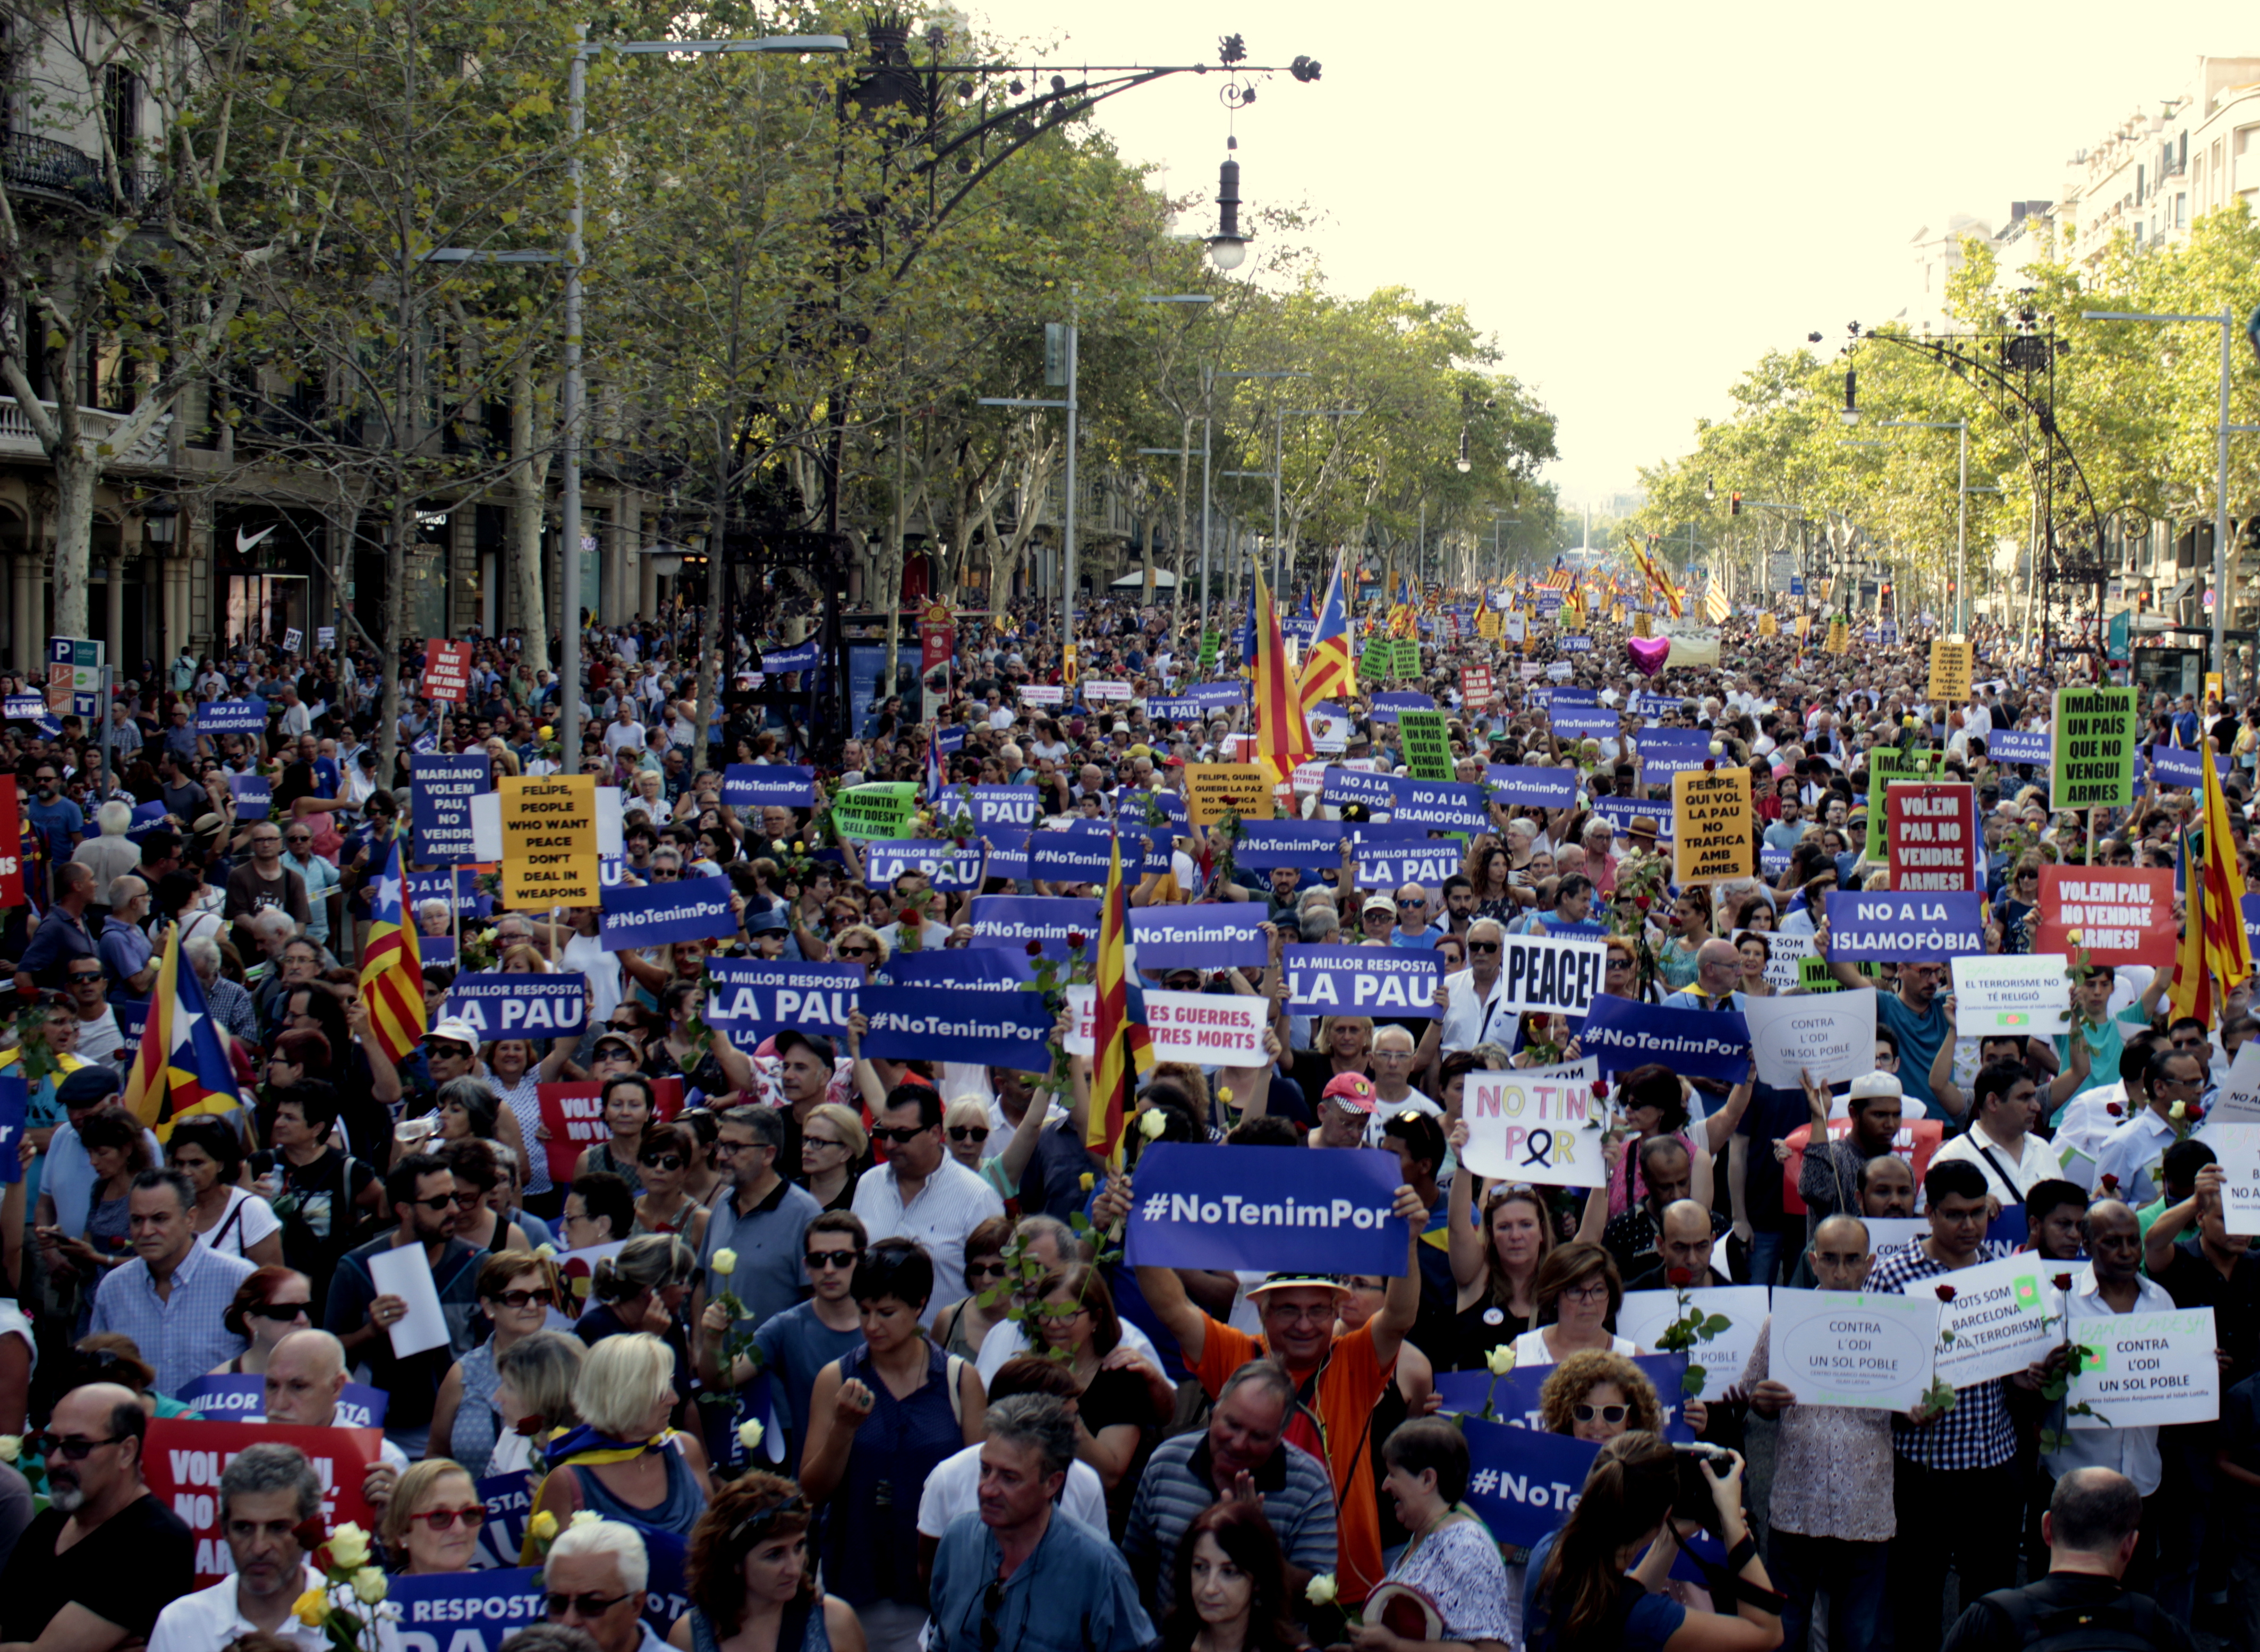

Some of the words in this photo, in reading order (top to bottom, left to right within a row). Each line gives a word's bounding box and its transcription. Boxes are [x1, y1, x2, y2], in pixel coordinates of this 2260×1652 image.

[56, 642, 70, 660] P
[5, 704, 19, 716] LA
[210, 707, 225, 716] NO
[1148, 705, 1167, 719] LA
[1170, 704, 1200, 718] PAU
[2065, 695, 2130, 714] IMAGINA
[1403, 716, 1441, 727] IMAGINA
[1554, 719, 1615, 728] #NoTenimPor
[2068, 719, 2089, 735] UN
[2092, 713, 2125, 735] PAÍS
[1407, 730, 1423, 740] UN
[1425, 727, 1441, 740] PAÍS
[1411, 743, 1428, 754] QUE
[1430, 743, 1442, 753] NO
[2069, 740, 2095, 760] QUE
[2098, 739, 2121, 757] NO
[1412, 756, 1444, 767] VENGUI
[415, 768, 484, 780] MARIANO
[1197, 774, 1230, 782] FELIPE,
[1416, 769, 1447, 780] ARMES
[2066, 762, 2120, 780] VENGUI
[425, 784, 475, 795] VOLEM
[522, 786, 572, 797] FELIPE,
[725, 780, 809, 793] #NoTenimPor
[1491, 777, 1570, 795] #NoTenimPor
[1687, 779, 1738, 792] FELIPE,
[2068, 784, 2119, 802] ARMES
[434, 798, 467, 812] PAU,
[1685, 793, 1710, 806] QUI
[1713, 792, 1742, 803] VOL
[1901, 797, 1959, 816] VOLEM
[521, 803, 574, 813] PEOPLE
[838, 807, 862, 820] THAT
[864, 809, 905, 824] DOESN'T
[1689, 808, 1707, 819] LA
[1710, 805, 1740, 818] PAU
[438, 813, 460, 824] NO
[1394, 808, 1486, 827] ISLAMOFÒBIA
[508, 821, 542, 831] WHO
[547, 820, 589, 830] WANT
[842, 821, 863, 834] SELL
[865, 824, 895, 837] ARMS
[1703, 821, 1723, 832] NO
[1685, 834, 1745, 849] TRAFICA
[1901, 822, 1937, 846] PAU,
[1941, 822, 1961, 841] NO
[526, 837, 572, 847] PEACE
[1237, 838, 1336, 853] #NoTenimPor
[529, 854, 571, 864] DON'T
[1358, 850, 1372, 859] LA
[1374, 849, 1408, 859] MILLOR
[1411, 847, 1458, 858] RESPOSTA
[1700, 849, 1731, 861] AMB
[1899, 847, 1964, 867] VENDRE
[524, 871, 559, 882] DEAL
[564, 870, 577, 880] IN
[1358, 860, 1393, 883] LA
[1403, 858, 1459, 882] PAU
[1691, 863, 1740, 877] ARMES
[1900, 872, 1965, 891] ARMES!
[516, 887, 587, 899] WEAPONS
[2059, 881, 2115, 902] VOLEM
[2119, 882, 2154, 905] PAU,
[607, 901, 726, 930] #NoTenimPor
[1858, 904, 1886, 921] NO
[1899, 904, 1916, 921] A
[1921, 904, 1948, 921] LA
[2061, 906, 2084, 924] NO
[2086, 906, 2152, 926] VENDRE
[973, 921, 1098, 940] #NoTenimPor
[1832, 925, 1981, 951] ISLAMOFÒBIA
[1289, 957, 1307, 968] LA
[1310, 958, 1363, 972] MILLOR
[1366, 960, 1437, 973] RESPOSTA
[709, 970, 727, 983] LA
[730, 972, 785, 986] MILLOR
[788, 974, 860, 989] RESPOSTA
[1507, 945, 1601, 1009] PEACE!
[1965, 980, 1977, 989] EL
[1978, 978, 2037, 989] TERRORISME
[2040, 977, 2059, 987] NO
[1288, 972, 1339, 1005] LA
[1354, 974, 1438, 1007] PAU
[1987, 991, 1999, 1002] TÉ
[2000, 991, 2040, 1002] RELIGIÓ
[708, 987, 762, 1020] LA
[775, 990, 859, 1026] PAU
[1175, 1006, 1256, 1030] GUERRES,
[1791, 1018, 1835, 1030] CONTRA
[869, 1012, 1045, 1041] #NoTenimPor
[1584, 1026, 1743, 1058] #NoTenimPor
[1780, 1048, 1795, 1058] UN
[1797, 1046, 1817, 1058] SOL
[1819, 1043, 1850, 1055] POBLE
[1476, 1085, 1526, 1118] NO
[1142, 1192, 1391, 1230] #NoTenimPor
[1952, 1294, 1981, 1312] TOTS
[1983, 1286, 2011, 1304] SOM
[1951, 1303, 2022, 1332] BARCELONA
[1829, 1321, 1881, 1334] CONTRA
[2117, 1338, 2169, 1353] CONTRA
[1702, 1351, 1738, 1363] POBLE
[1809, 1355, 1829, 1367] UN
[1831, 1356, 1856, 1368] SOL
[1859, 1358, 1898, 1372] POBLE
[2098, 1381, 2120, 1392] UN
[2122, 1378, 2146, 1391] SOL
[2150, 1375, 2190, 1389] POBLE
[173, 1493, 215, 1530] NO
